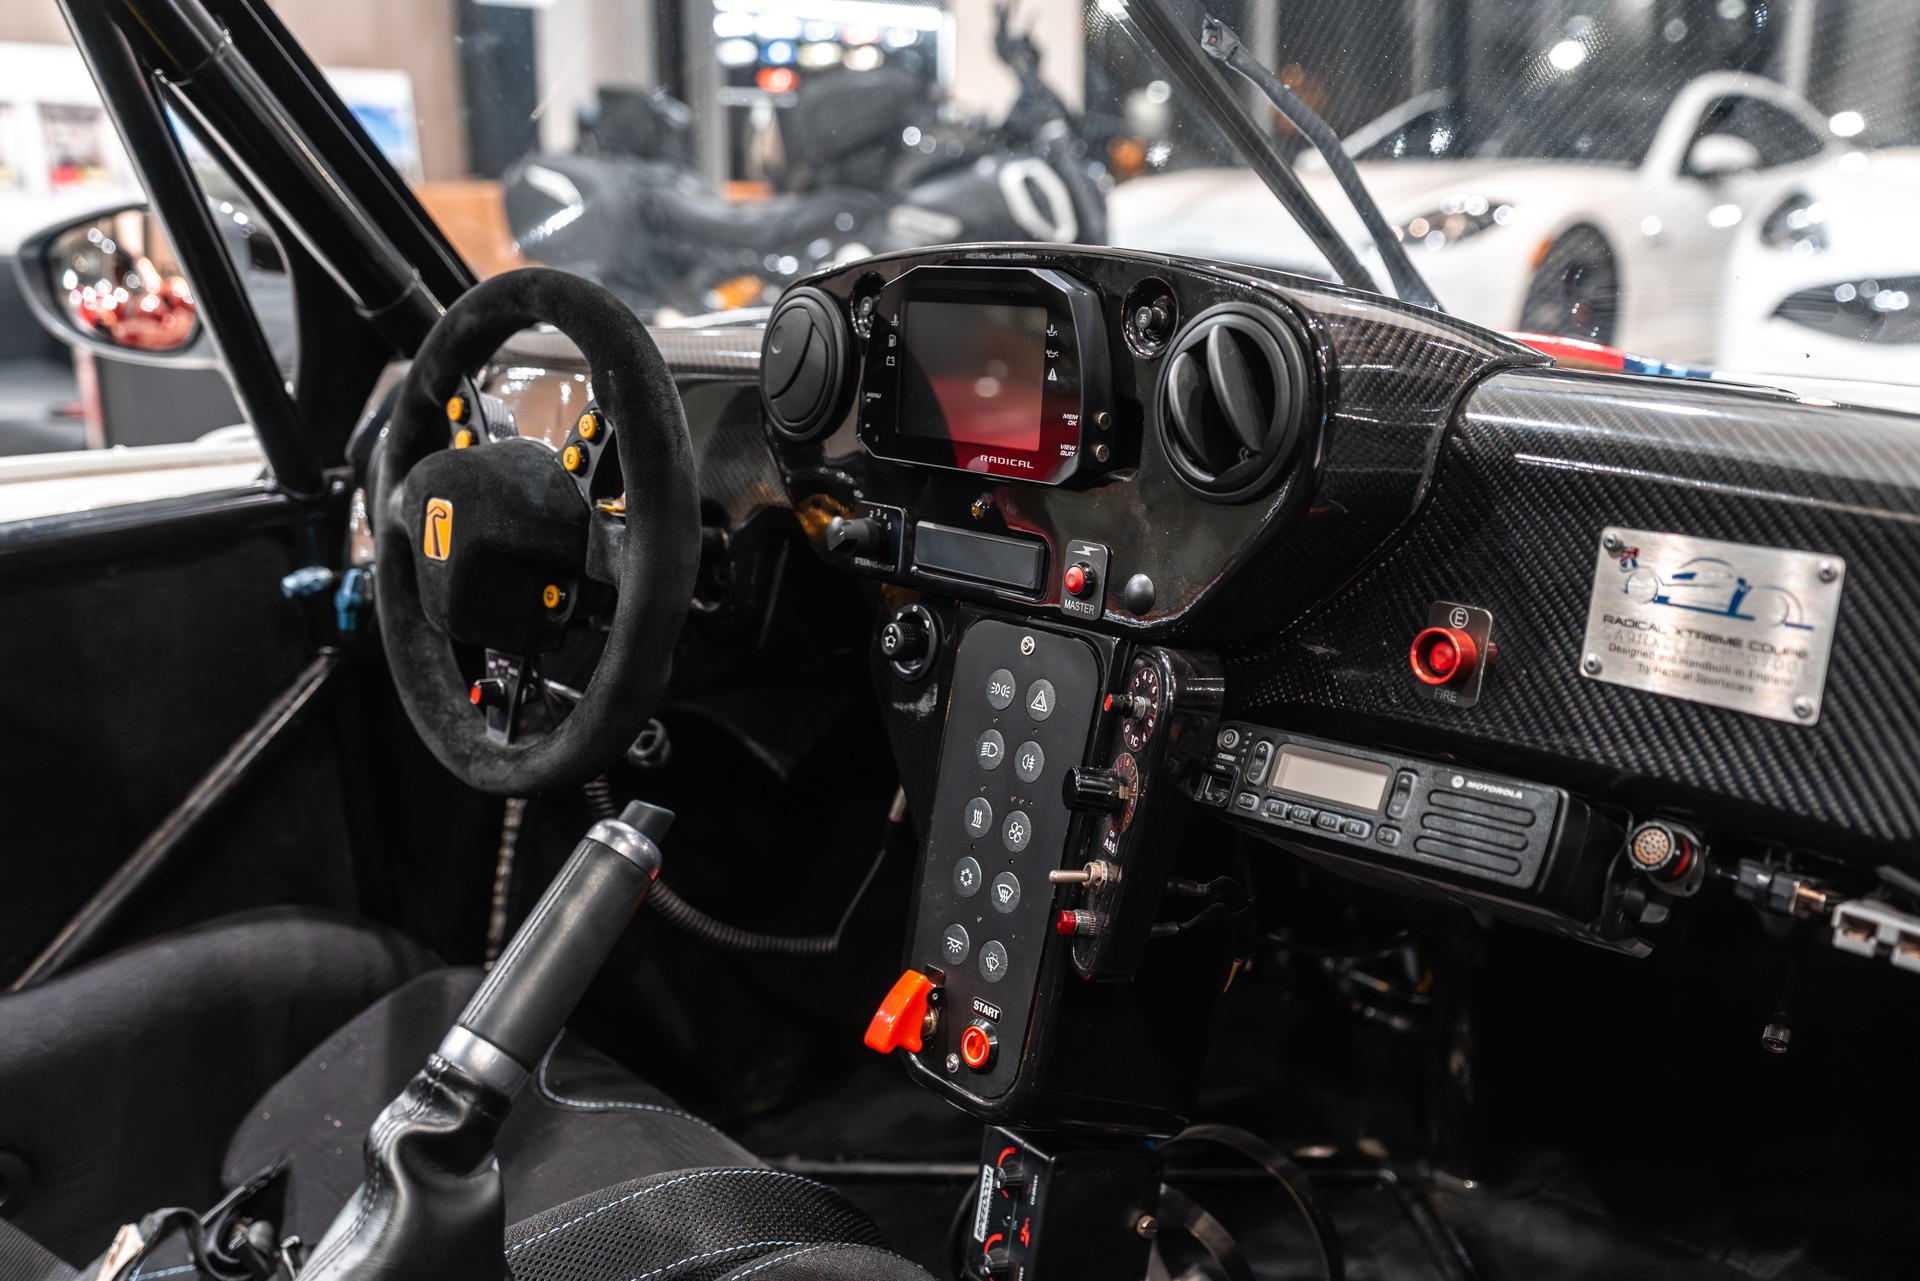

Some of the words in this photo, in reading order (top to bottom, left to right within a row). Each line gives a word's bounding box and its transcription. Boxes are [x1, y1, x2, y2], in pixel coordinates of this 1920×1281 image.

[1060, 443, 1077, 451] VIEW
[980, 454, 1034, 470] RADICAL
[869, 510, 874, 518] 2
[876, 508, 881, 516] 3
[882, 512, 888, 520] 4
[887, 521, 892, 531] 5
[1063, 598, 1095, 615] MASTER
[1454, 610, 1465, 626] E
[1603, 614, 1667, 635] RADICAL
[1608, 643, 1655, 660] Designed
[1638, 662, 1652, 675] by
[1142, 671, 1147, 681] 4
[1434, 687, 1458, 703] FIRE
[1130, 734, 1139, 747] TC
[1466, 780, 1523, 800] MOTOROLA
[1270, 802, 1280, 813] P1
[1299, 809, 1309, 820] P2
[1320, 815, 1331, 825] P3
[1350, 822, 1361, 833] P4
[1103, 837, 1116, 854] ABS
[973, 1000, 1000, 1019] START
